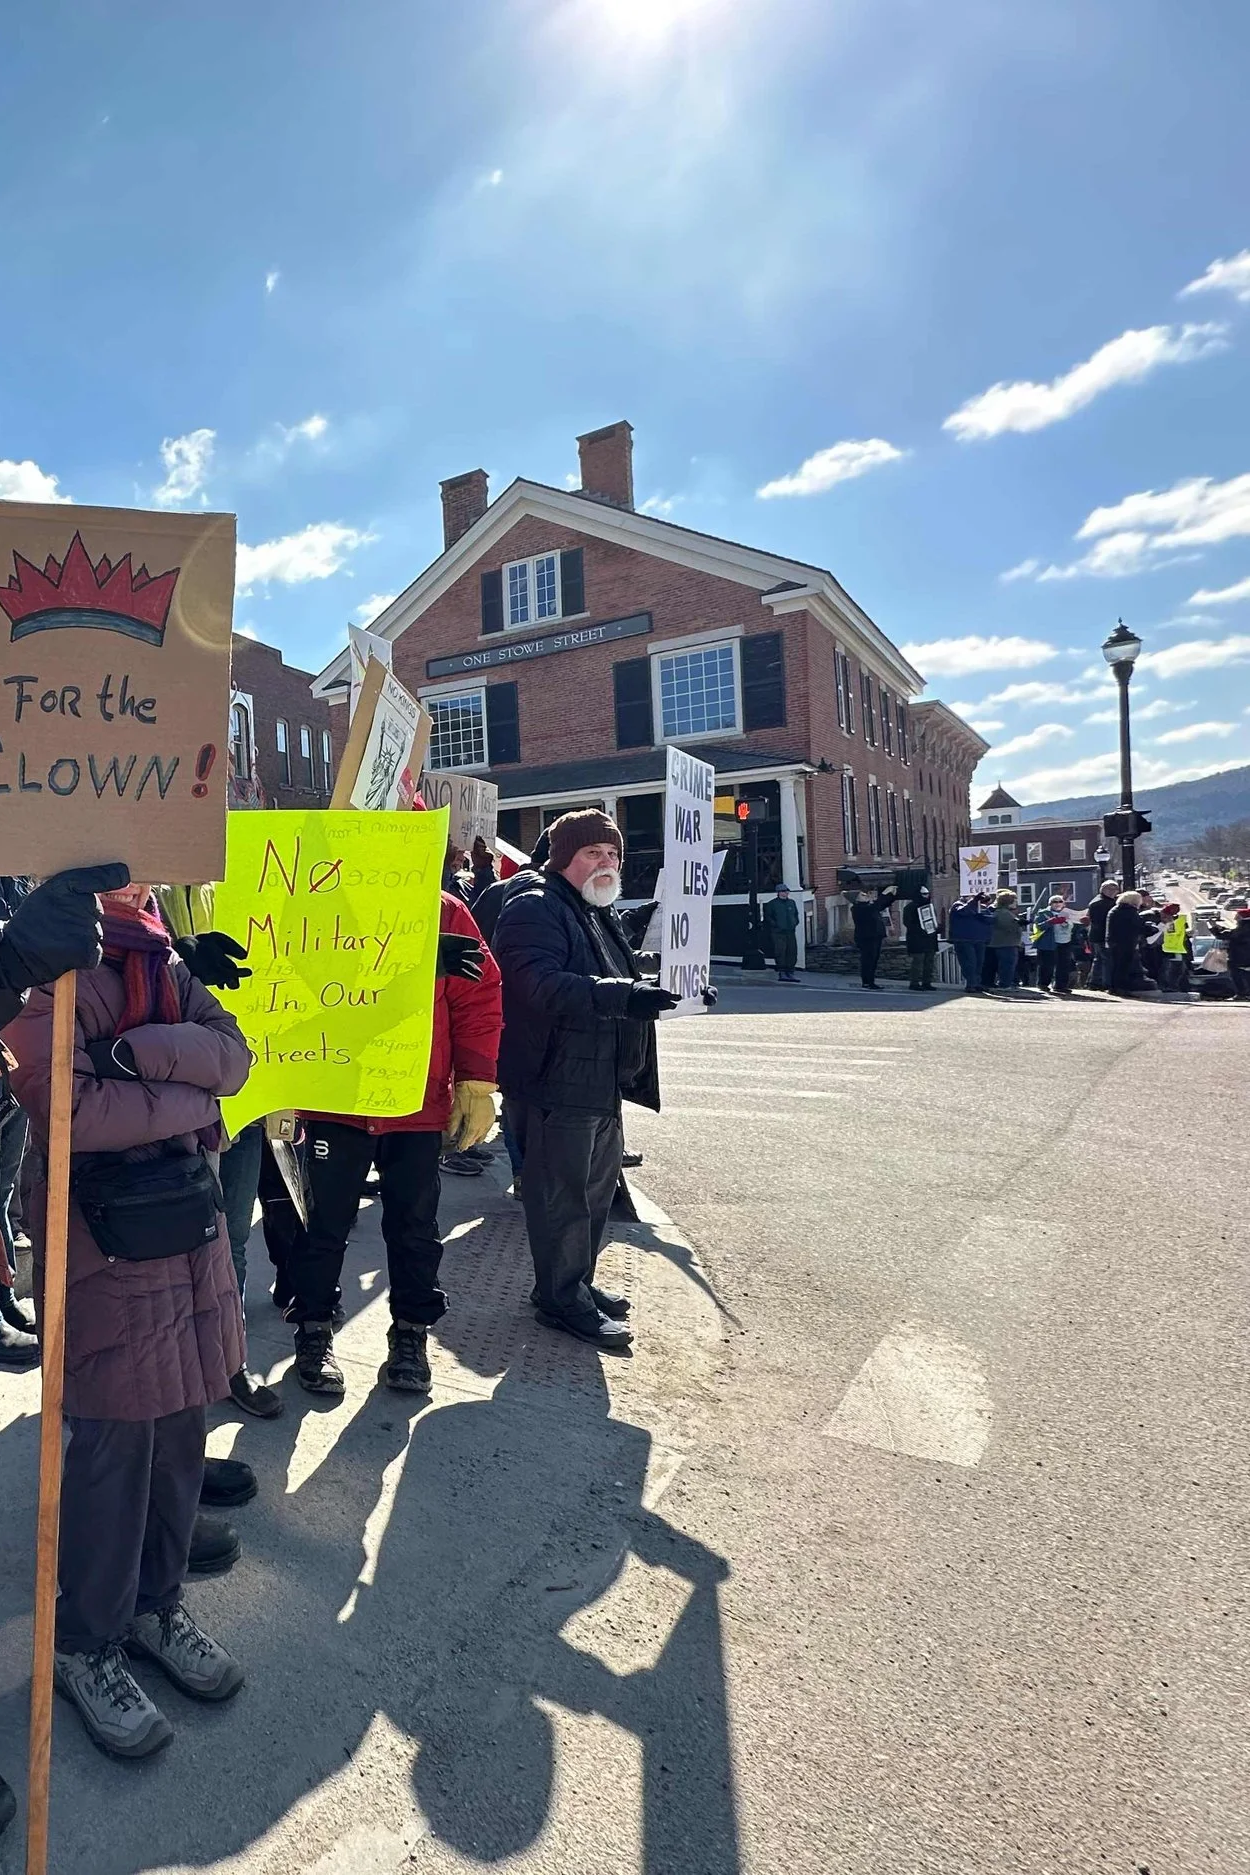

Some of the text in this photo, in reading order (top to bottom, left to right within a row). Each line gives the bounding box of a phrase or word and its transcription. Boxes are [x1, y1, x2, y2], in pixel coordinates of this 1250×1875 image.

[462, 626, 607, 668] ONE STOWE STREET
[96, 673, 157, 724] the
[387, 681, 417, 719] NO KINGS
[424, 778, 453, 809] NO
[670, 751, 713, 802] CRIME
[674, 803, 702, 845] WAR
[682, 859, 709, 897] LIES
[968, 878, 993, 886] KINGS
[247, 913, 393, 972] Military
[670, 911, 690, 950] NO
[265, 980, 299, 1013] In
[320, 981, 386, 1008] Our
[669, 963, 708, 999] KINGS
